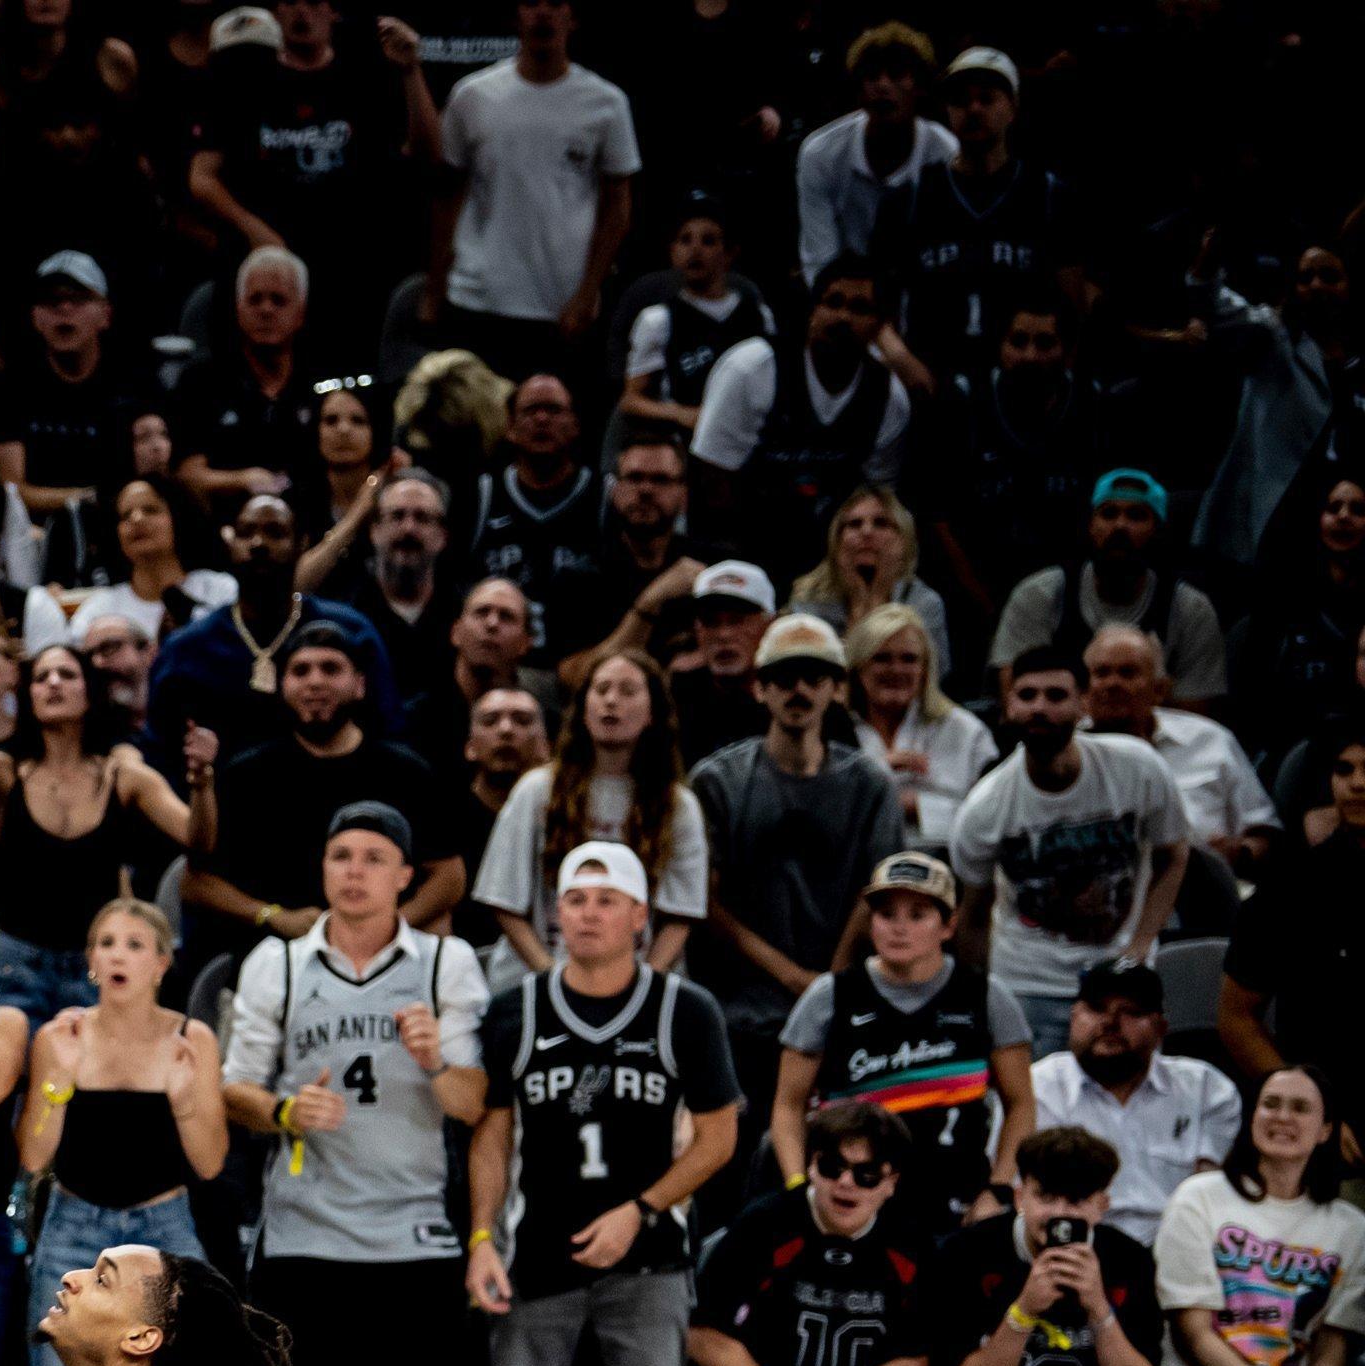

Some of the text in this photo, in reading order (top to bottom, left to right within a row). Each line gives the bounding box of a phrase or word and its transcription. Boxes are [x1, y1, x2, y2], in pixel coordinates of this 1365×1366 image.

[343, 1055, 378, 1104] 4
[523, 1064, 667, 1115] SPURS
[578, 1121, 610, 1179] 1
[1214, 1226, 1340, 1287] SPURS
